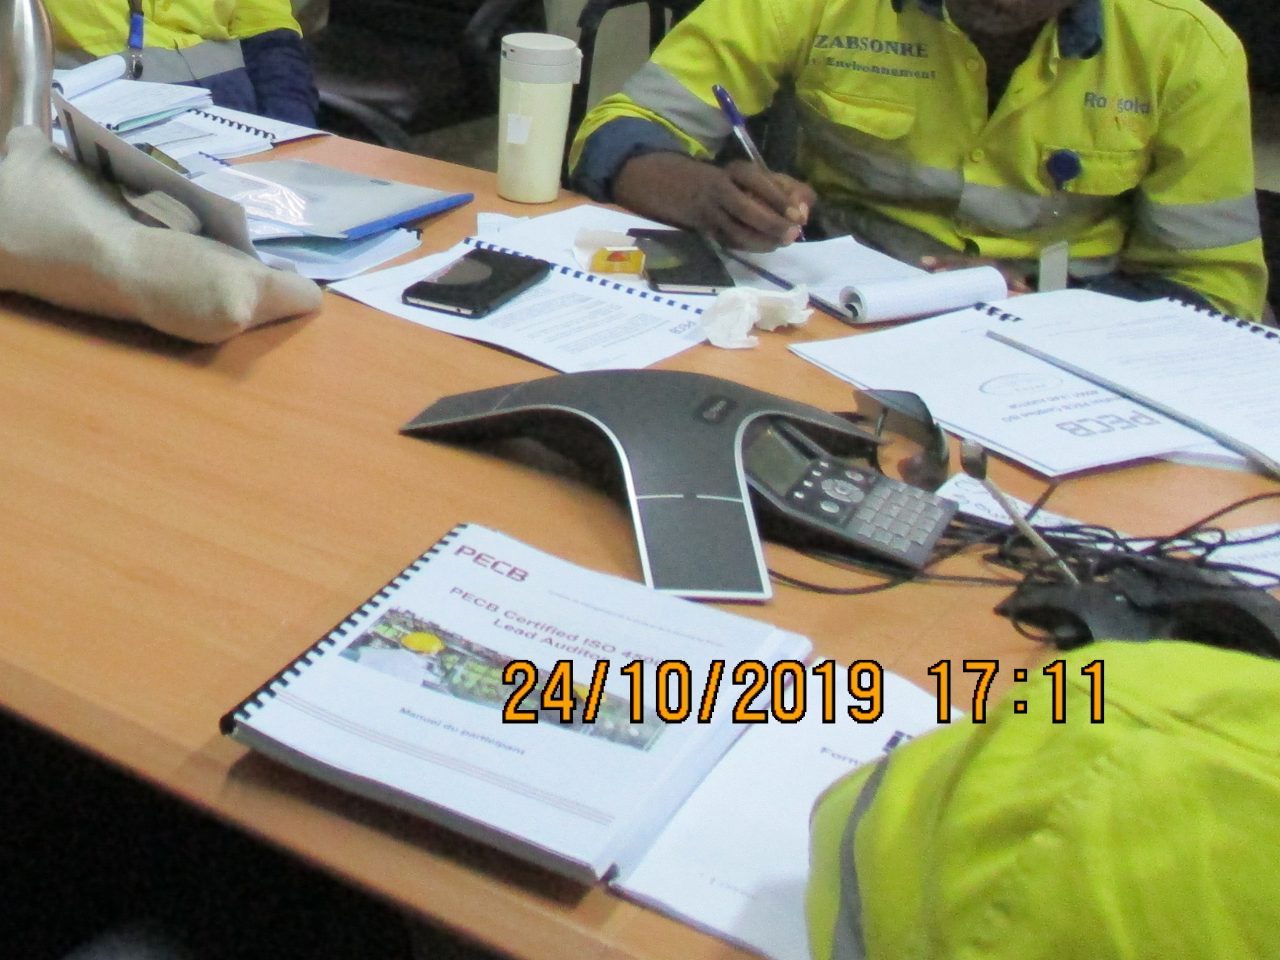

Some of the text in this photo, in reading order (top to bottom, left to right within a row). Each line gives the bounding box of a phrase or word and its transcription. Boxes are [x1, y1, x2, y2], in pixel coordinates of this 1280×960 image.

[814, 35, 929, 58] ZABSONRE
[1055, 409, 1162, 437] PECB
[454, 545, 530, 583] PECB
[449, 586, 499, 613] PECB
[503, 610, 579, 642] Certified
[583, 638, 616, 653] ISO
[493, 618, 537, 639] Lead
[400, 707, 441, 726] Manuel
[443, 720, 458, 733] du
